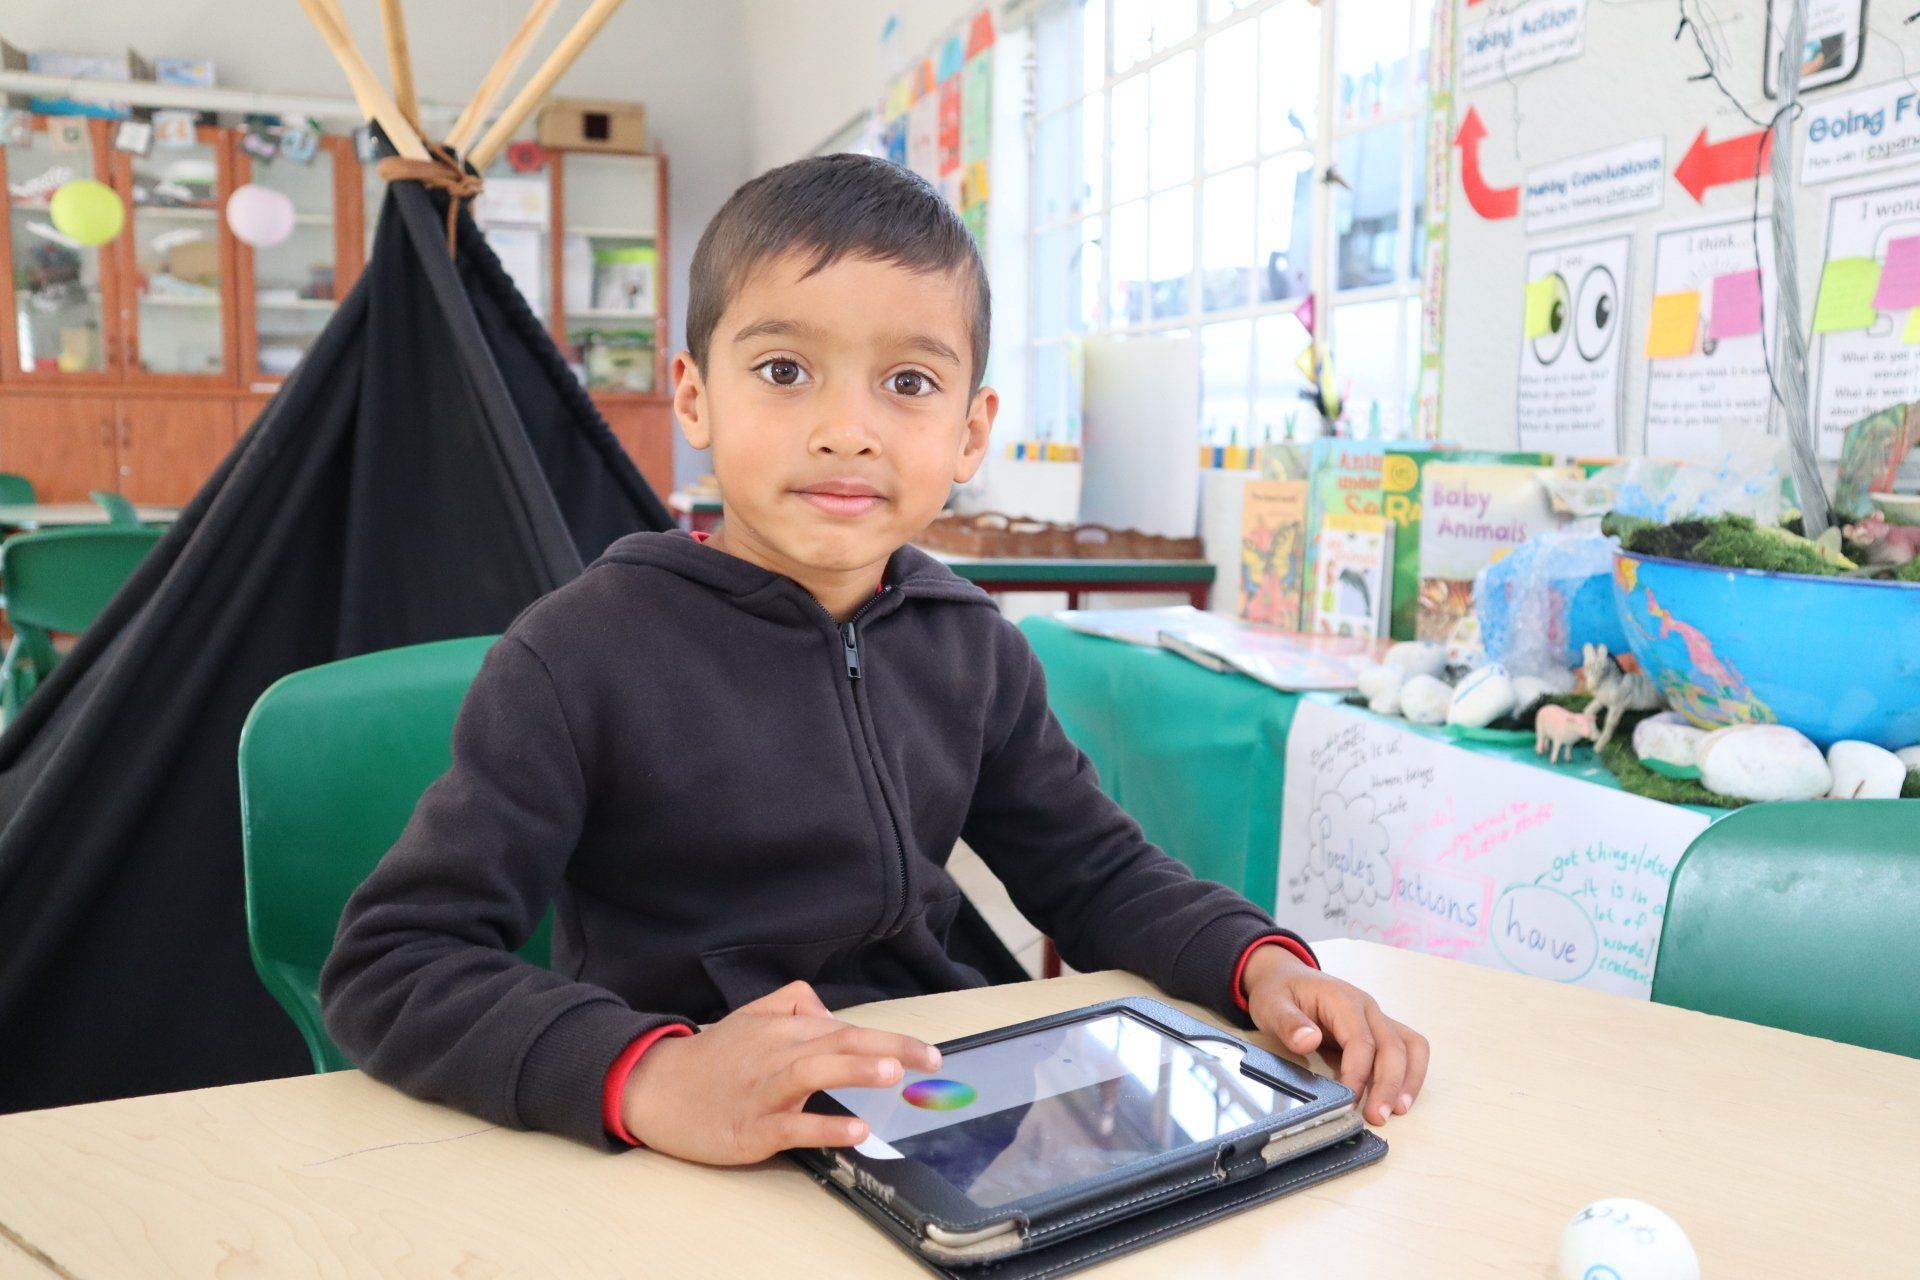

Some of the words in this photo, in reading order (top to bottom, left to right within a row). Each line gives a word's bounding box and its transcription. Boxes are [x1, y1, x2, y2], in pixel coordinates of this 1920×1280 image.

[1521, 5, 1577, 36] Action
[1809, 108, 1885, 142] Going
[1433, 482, 1491, 518] Baby
[1438, 519, 1527, 543] Animals
[1397, 872, 1478, 927] actions
[1506, 897, 1576, 964] have
